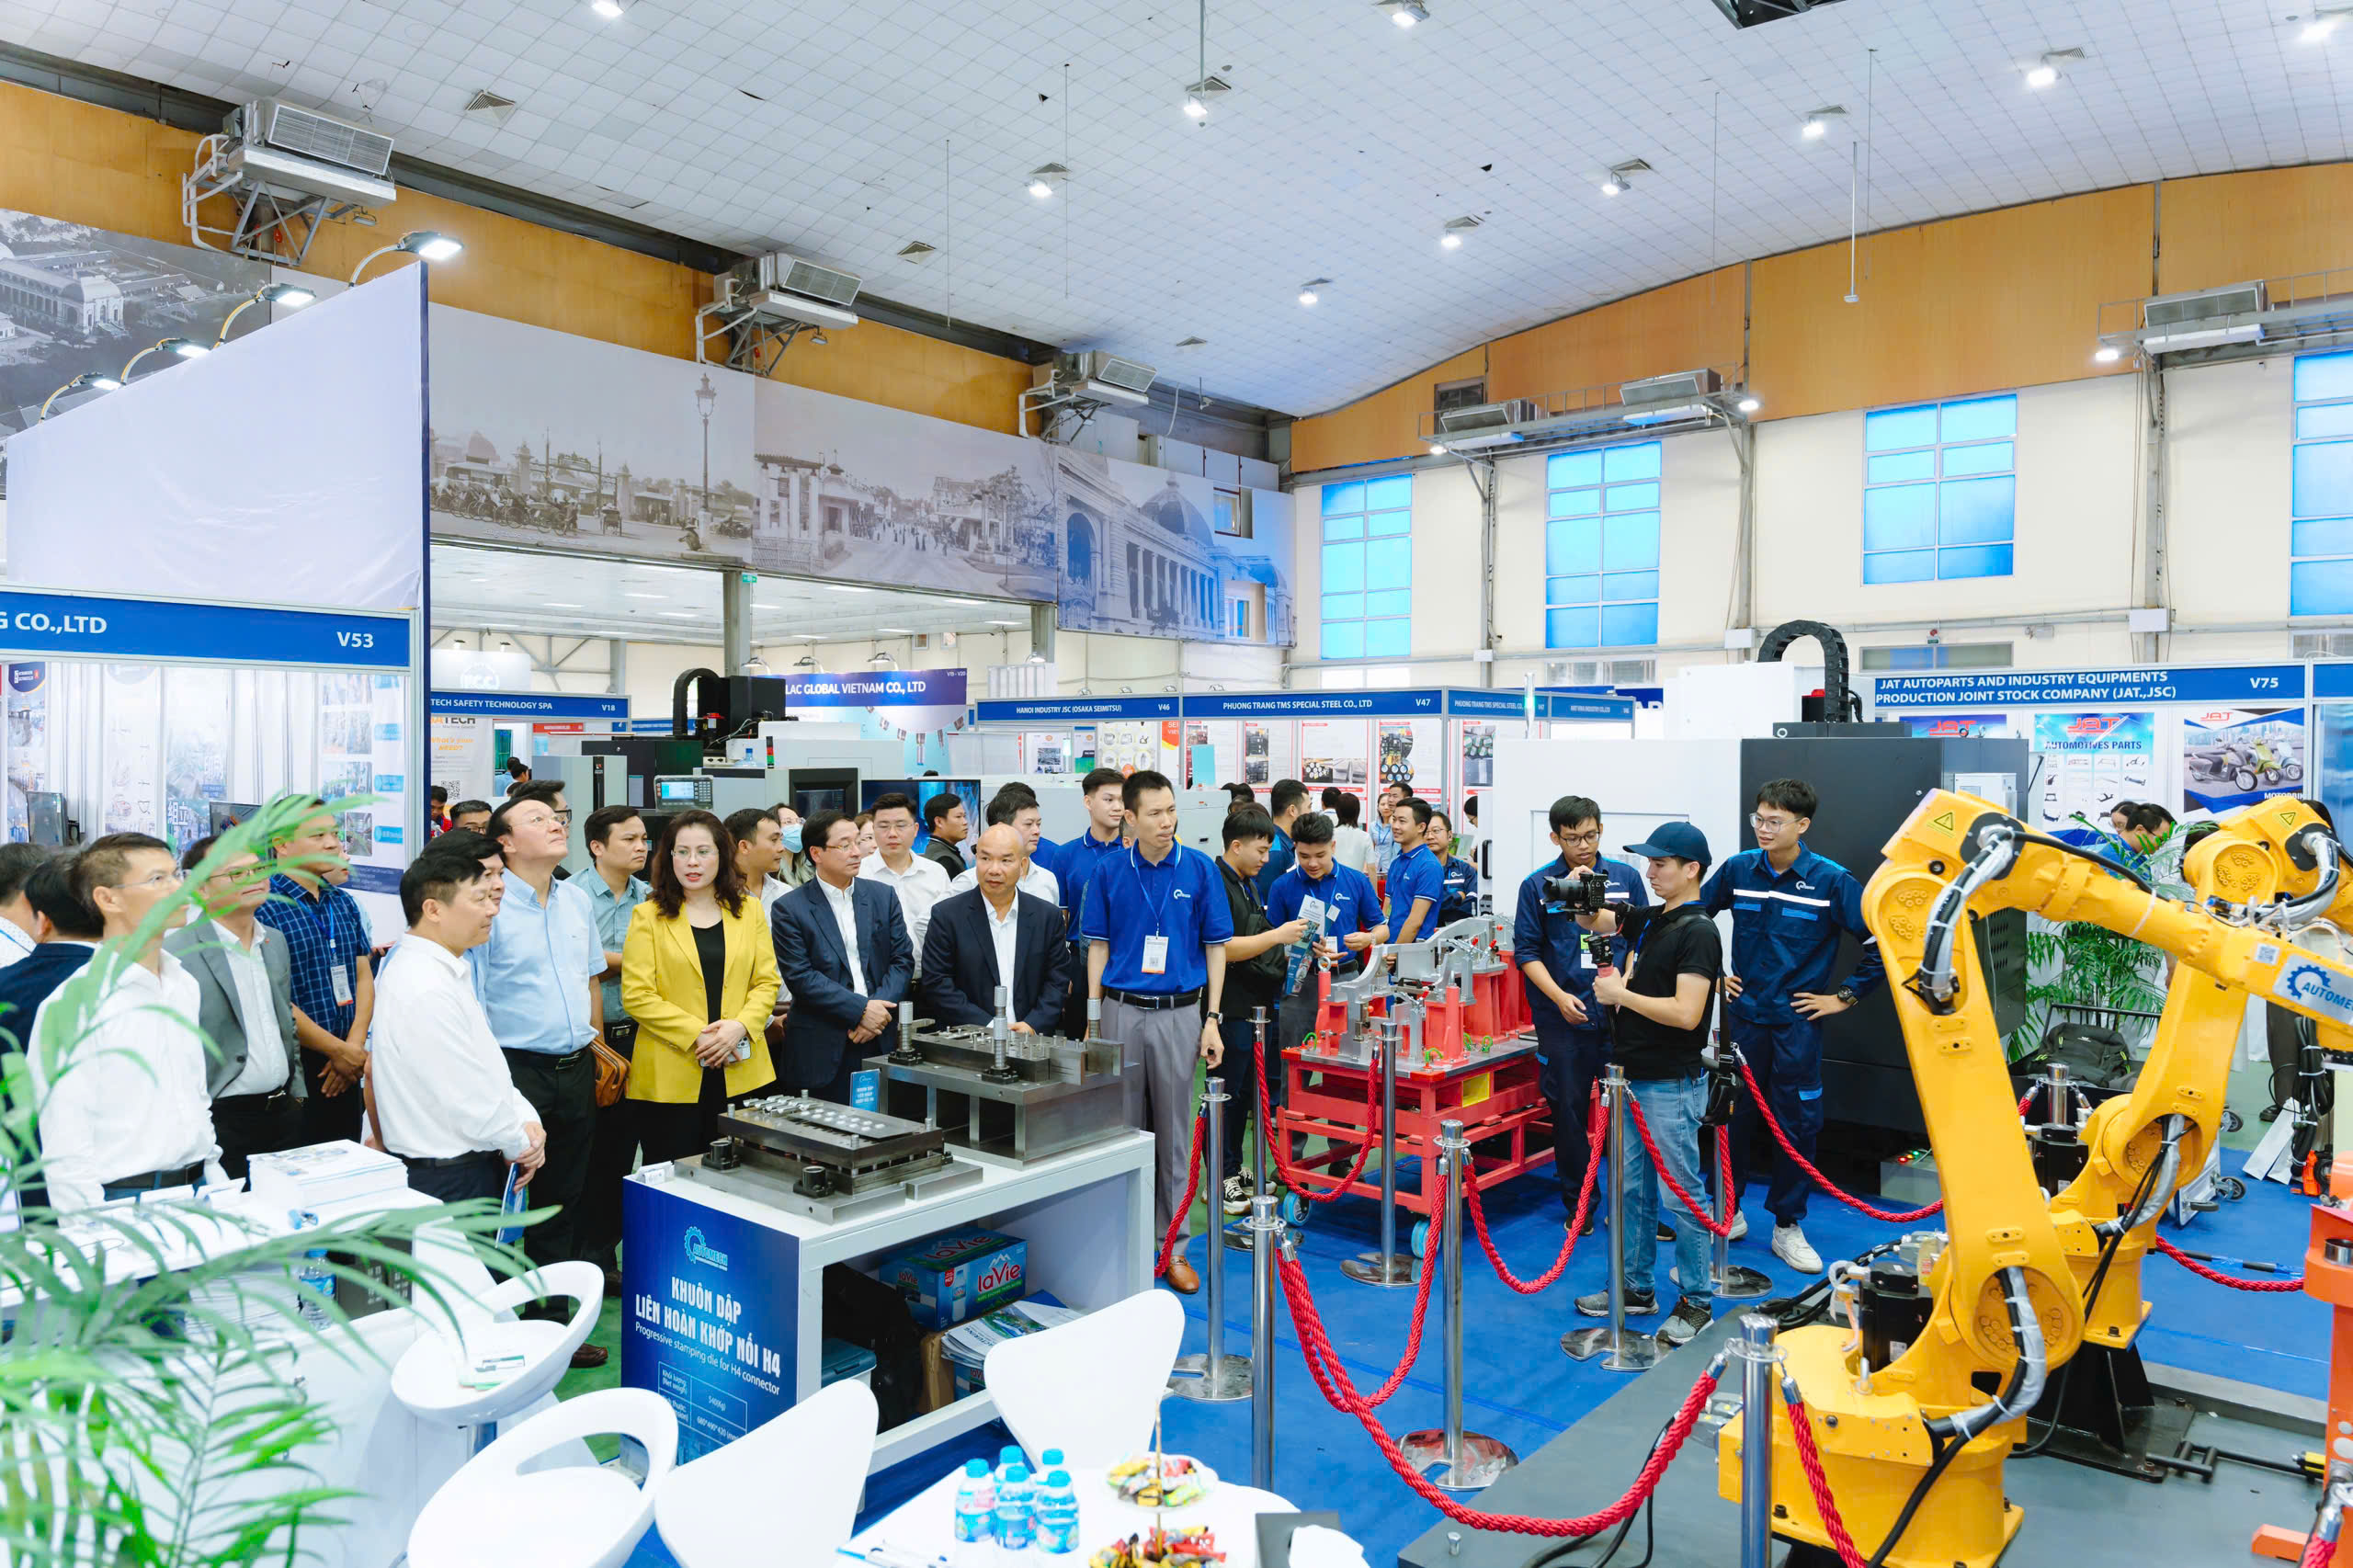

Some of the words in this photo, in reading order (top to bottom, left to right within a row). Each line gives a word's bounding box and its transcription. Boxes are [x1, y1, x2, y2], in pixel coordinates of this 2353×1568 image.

[15, 612, 108, 634] CO.,LTD
[336, 631, 374, 648] V53
[803, 684, 840, 695] GLOBAL
[842, 683, 884, 694] VIETNAM
[907, 681, 926, 693] LTD
[1880, 680, 1901, 689] JAT
[1903, 677, 1974, 688] AUTOPARTS
[1977, 676, 2006, 687] AND
[2008, 674, 2075, 686] INDUSTRY
[2078, 671, 2168, 684] EQUIPMENTS
[2250, 677, 2279, 688] V75
[1415, 699, 1431, 707] V47
[1875, 692, 1955, 703] PRODUCTION
[1958, 691, 1995, 701] JOINT
[1997, 689, 2040, 700] STOCK
[2046, 687, 2109, 699] COMPANY
[2112, 687, 2177, 699] (JAT.,JSC)
[431, 699, 451, 707] TECH
[453, 699, 483, 708] SAFETY
[484, 700, 538, 710] TECHNOLOGY
[1072, 705, 1093, 713] (OSAKA
[1094, 704, 1122, 713] SEIMITSU)
[1223, 701, 1252, 710] PHUONG
[1253, 701, 1276, 710] TRANG
[1277, 700, 1291, 709] TMS
[1292, 700, 1320, 709] SPECIAL
[1321, 700, 1342, 709] STEEL
[1358, 699, 1372, 708] LTD
[2067, 717, 2121, 732] JAT
[2112, 741, 2142, 749] PARTS
[2302, 982, 2353, 1009] AUTOME
[693, 1243, 729, 1267] AUTOMECH
[898, 1271, 918, 1285] laVie
[978, 1262, 1021, 1292] laVie
[671, 1276, 712, 1313] KHUÔN
[716, 1293, 742, 1327] DẬP
[635, 1293, 661, 1324] LIÊN
[664, 1305, 696, 1339] HOÀN
[700, 1320, 733, 1355] KHỚP
[736, 1332, 759, 1368] NỐI
[763, 1347, 780, 1379] H4
[963, 1326, 995, 1346] ACTURING
[635, 1321, 673, 1346] Progressive
[674, 1339, 707, 1364] stamping
[707, 1353, 719, 1368] die
[720, 1358, 730, 1372] for
[731, 1364, 742, 1378] H4
[742, 1369, 780, 1396] connector
[970, 1367, 984, 1379] laVi
